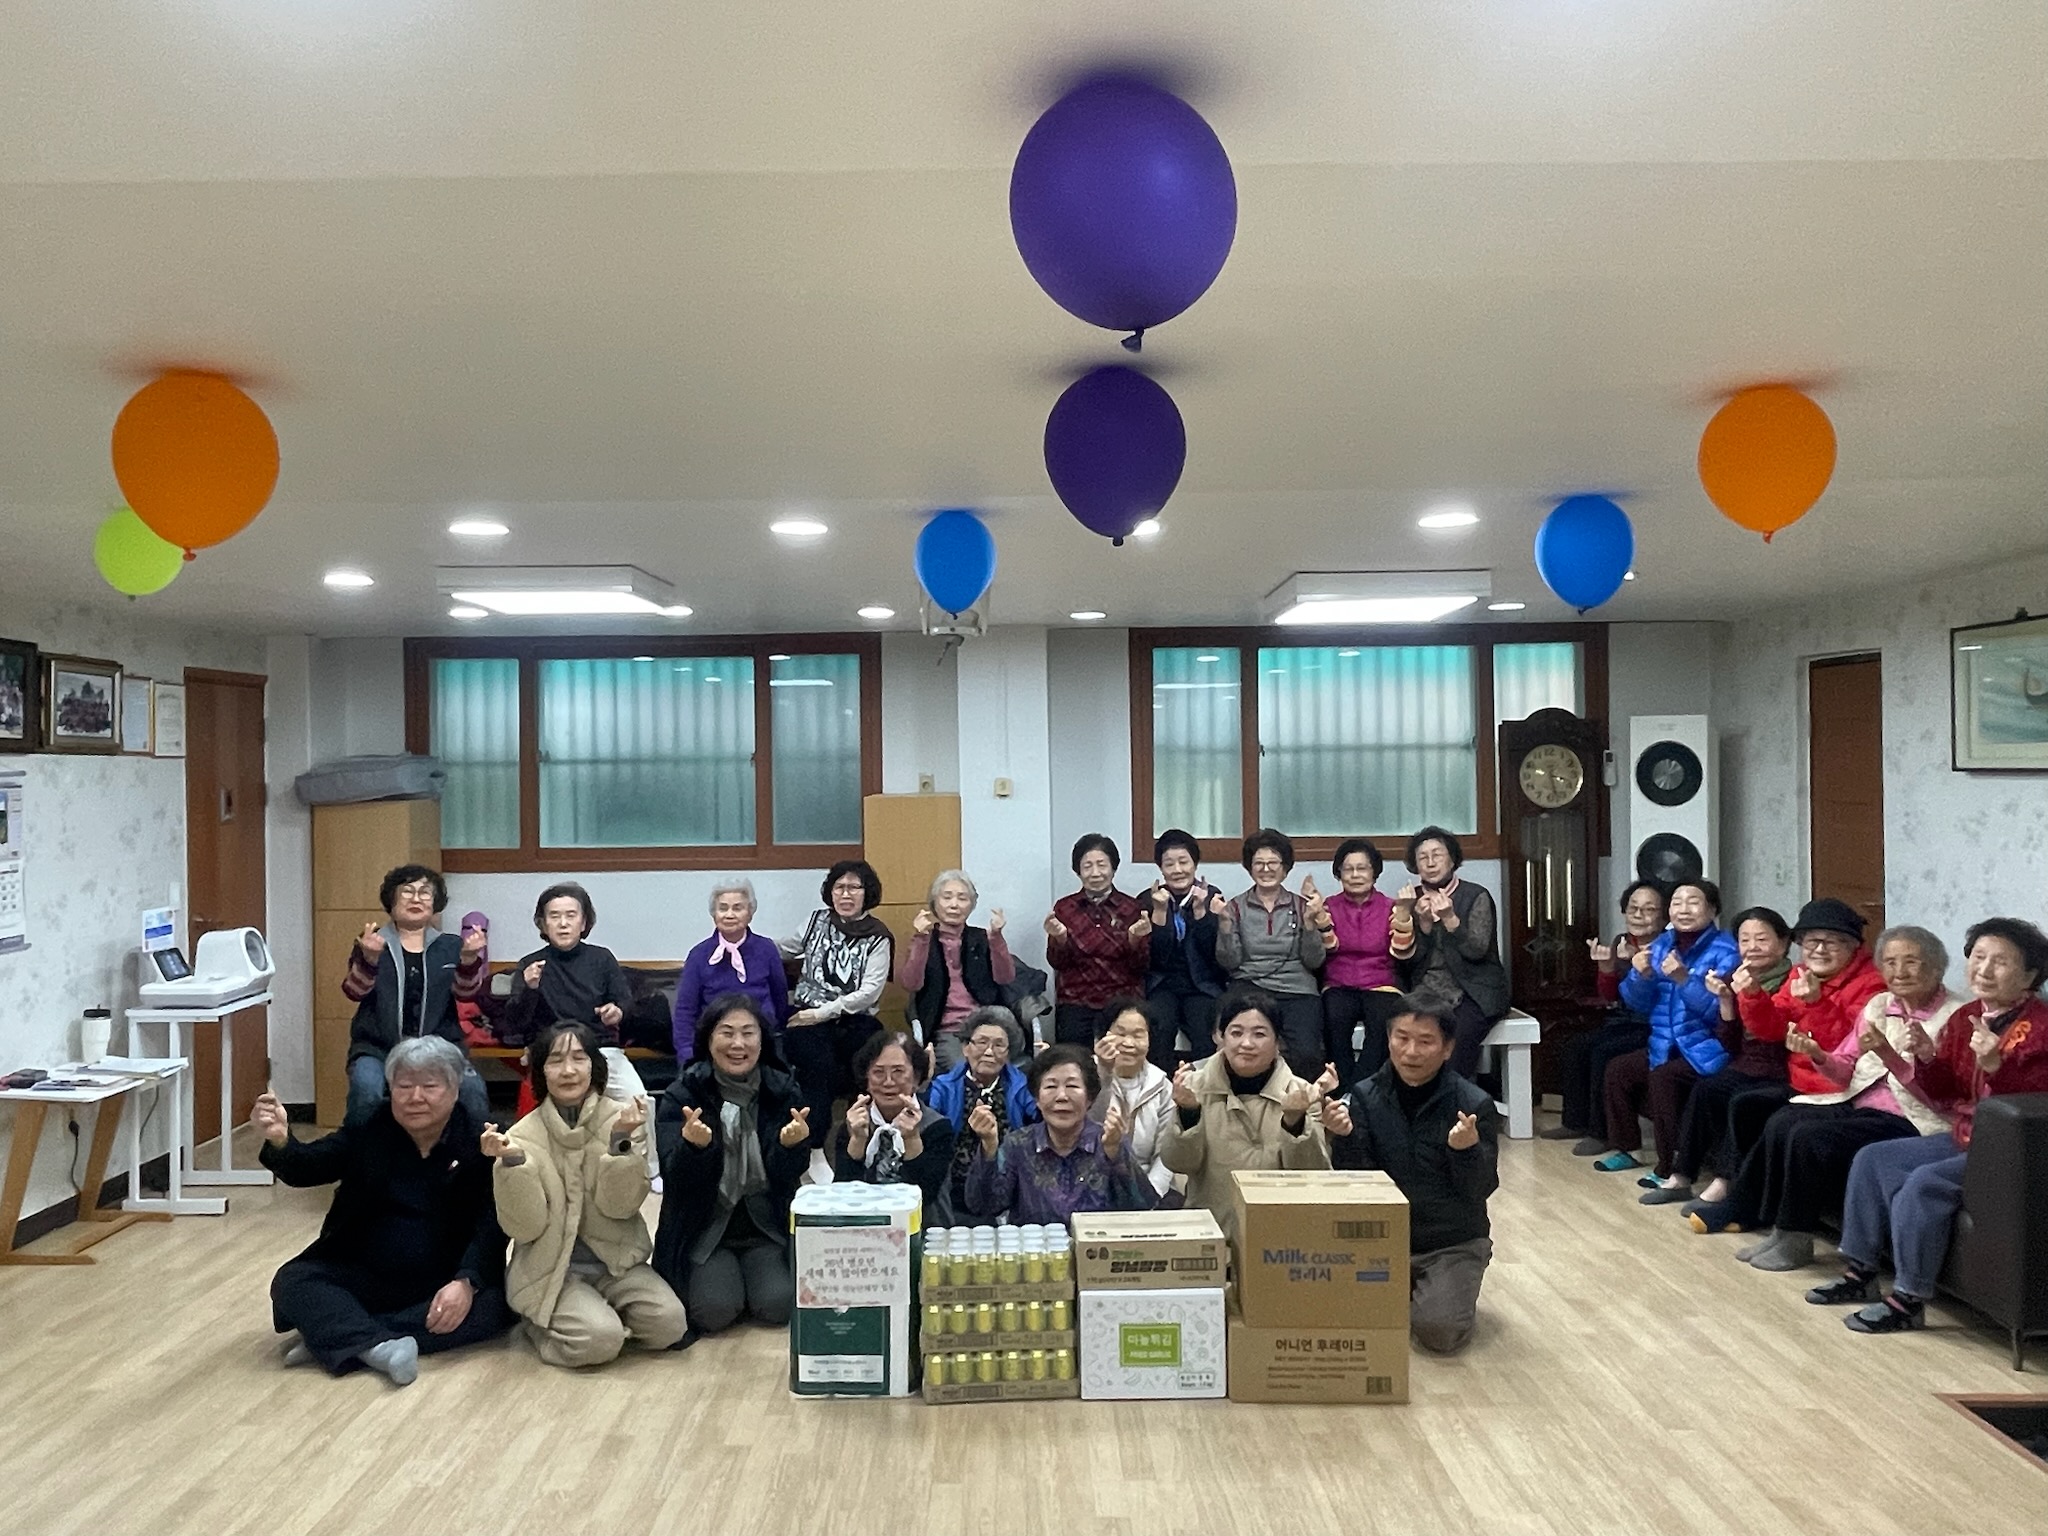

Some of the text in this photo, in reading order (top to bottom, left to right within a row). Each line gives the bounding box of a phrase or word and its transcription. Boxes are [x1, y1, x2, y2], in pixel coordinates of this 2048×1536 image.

[1263, 1249, 1308, 1264] Milk
[1311, 1253, 1356, 1264] CLASSIC
[1275, 1338, 1366, 1352] 어니언 후레이크
